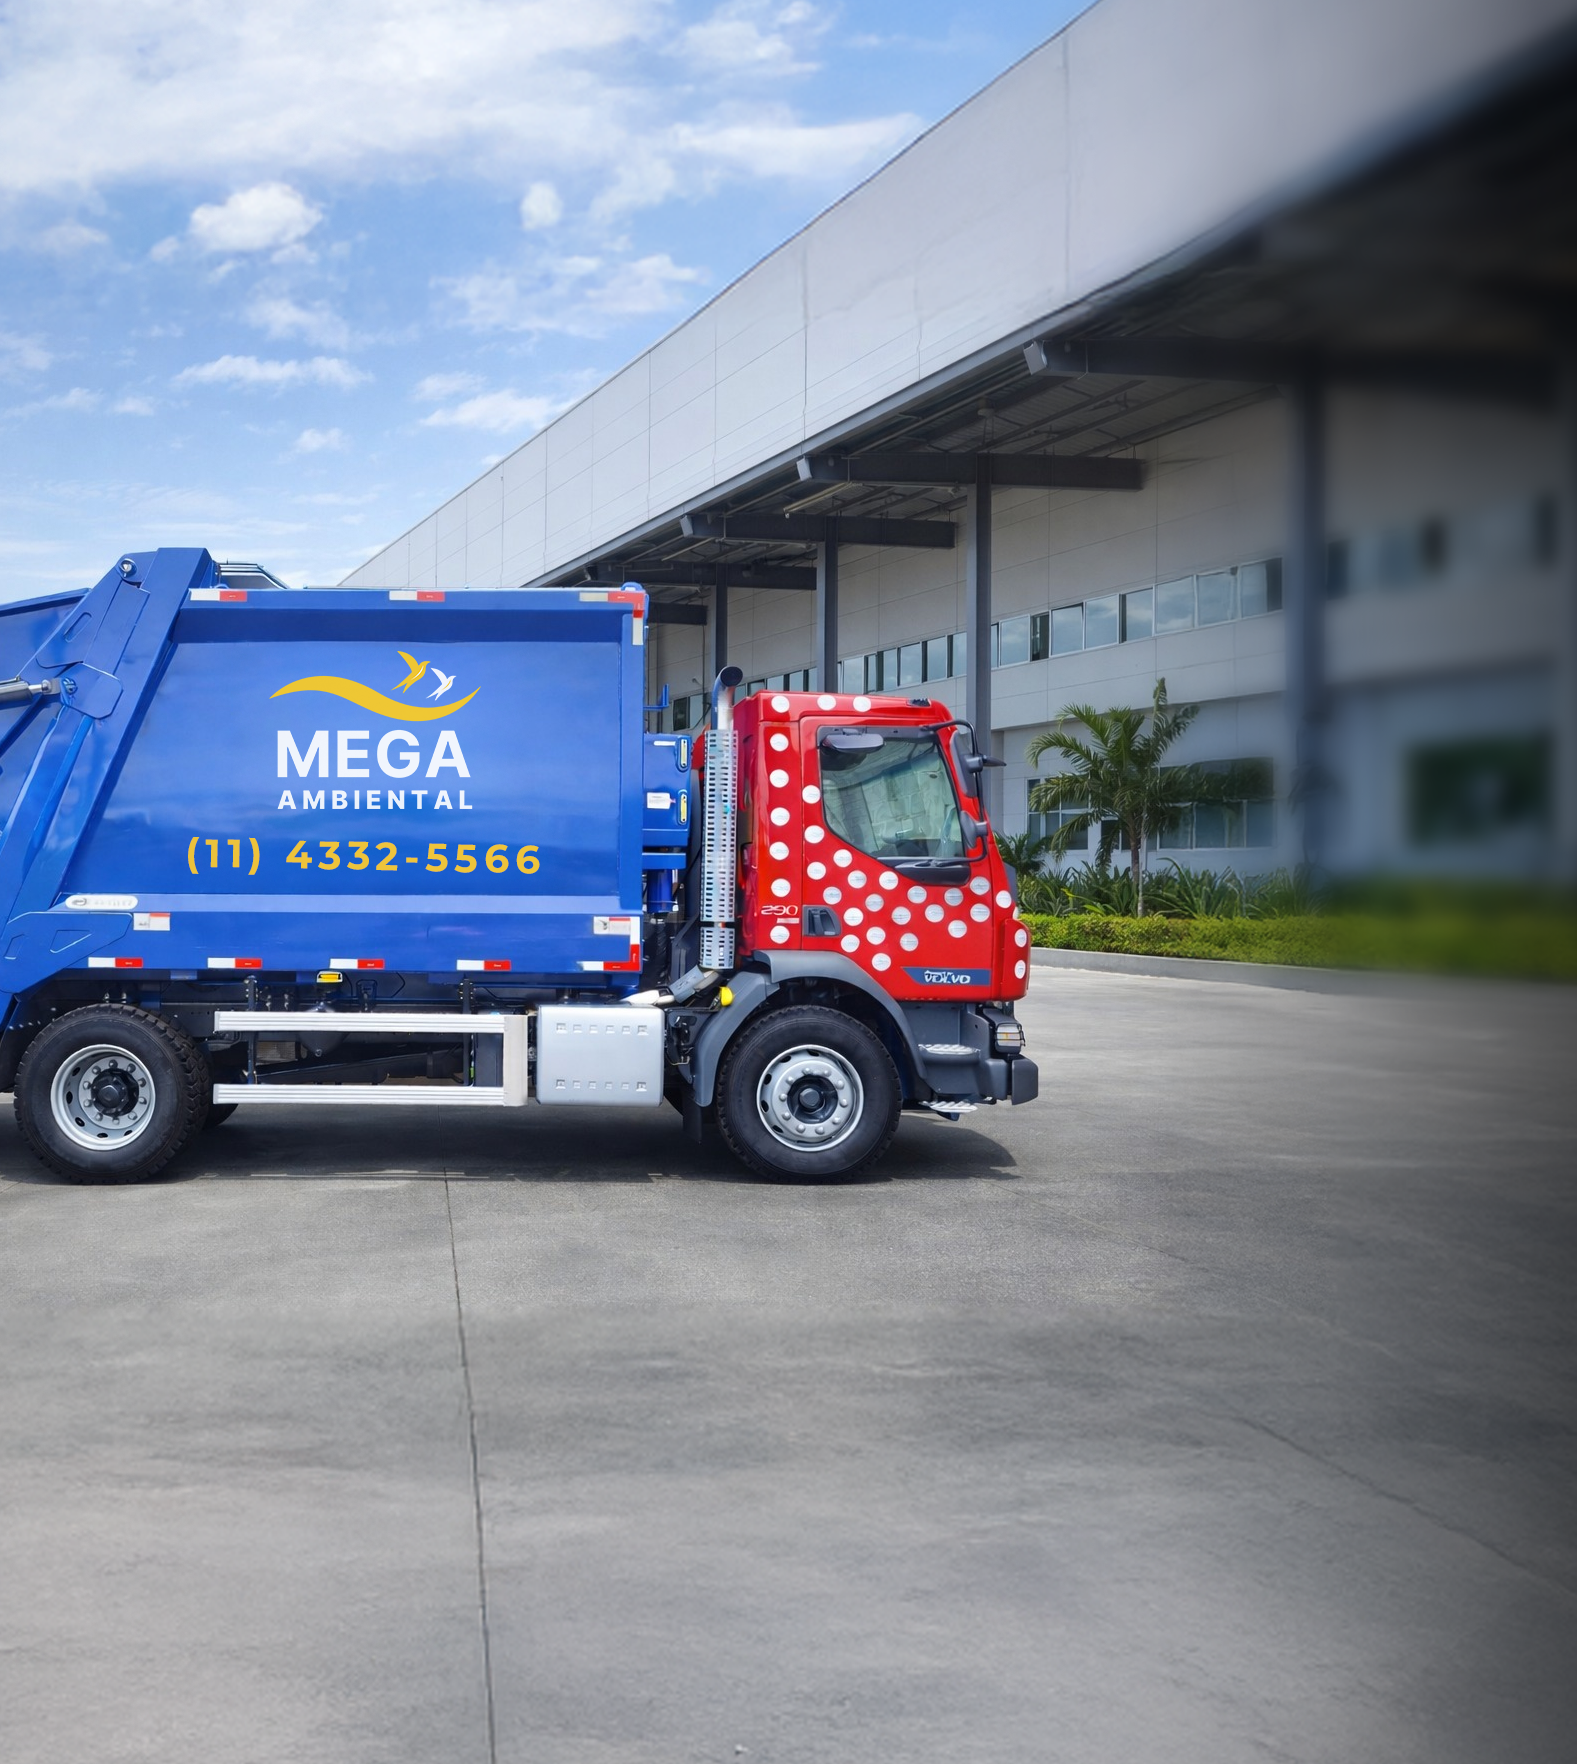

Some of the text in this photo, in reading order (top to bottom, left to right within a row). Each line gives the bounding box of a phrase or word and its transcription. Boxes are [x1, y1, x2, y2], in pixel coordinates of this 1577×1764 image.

[276, 729, 471, 778] MEGA
[277, 789, 473, 810] AMBIENTAL
[187, 836, 540, 876] (11) 4332-5566
[760, 904, 799, 916] 290
